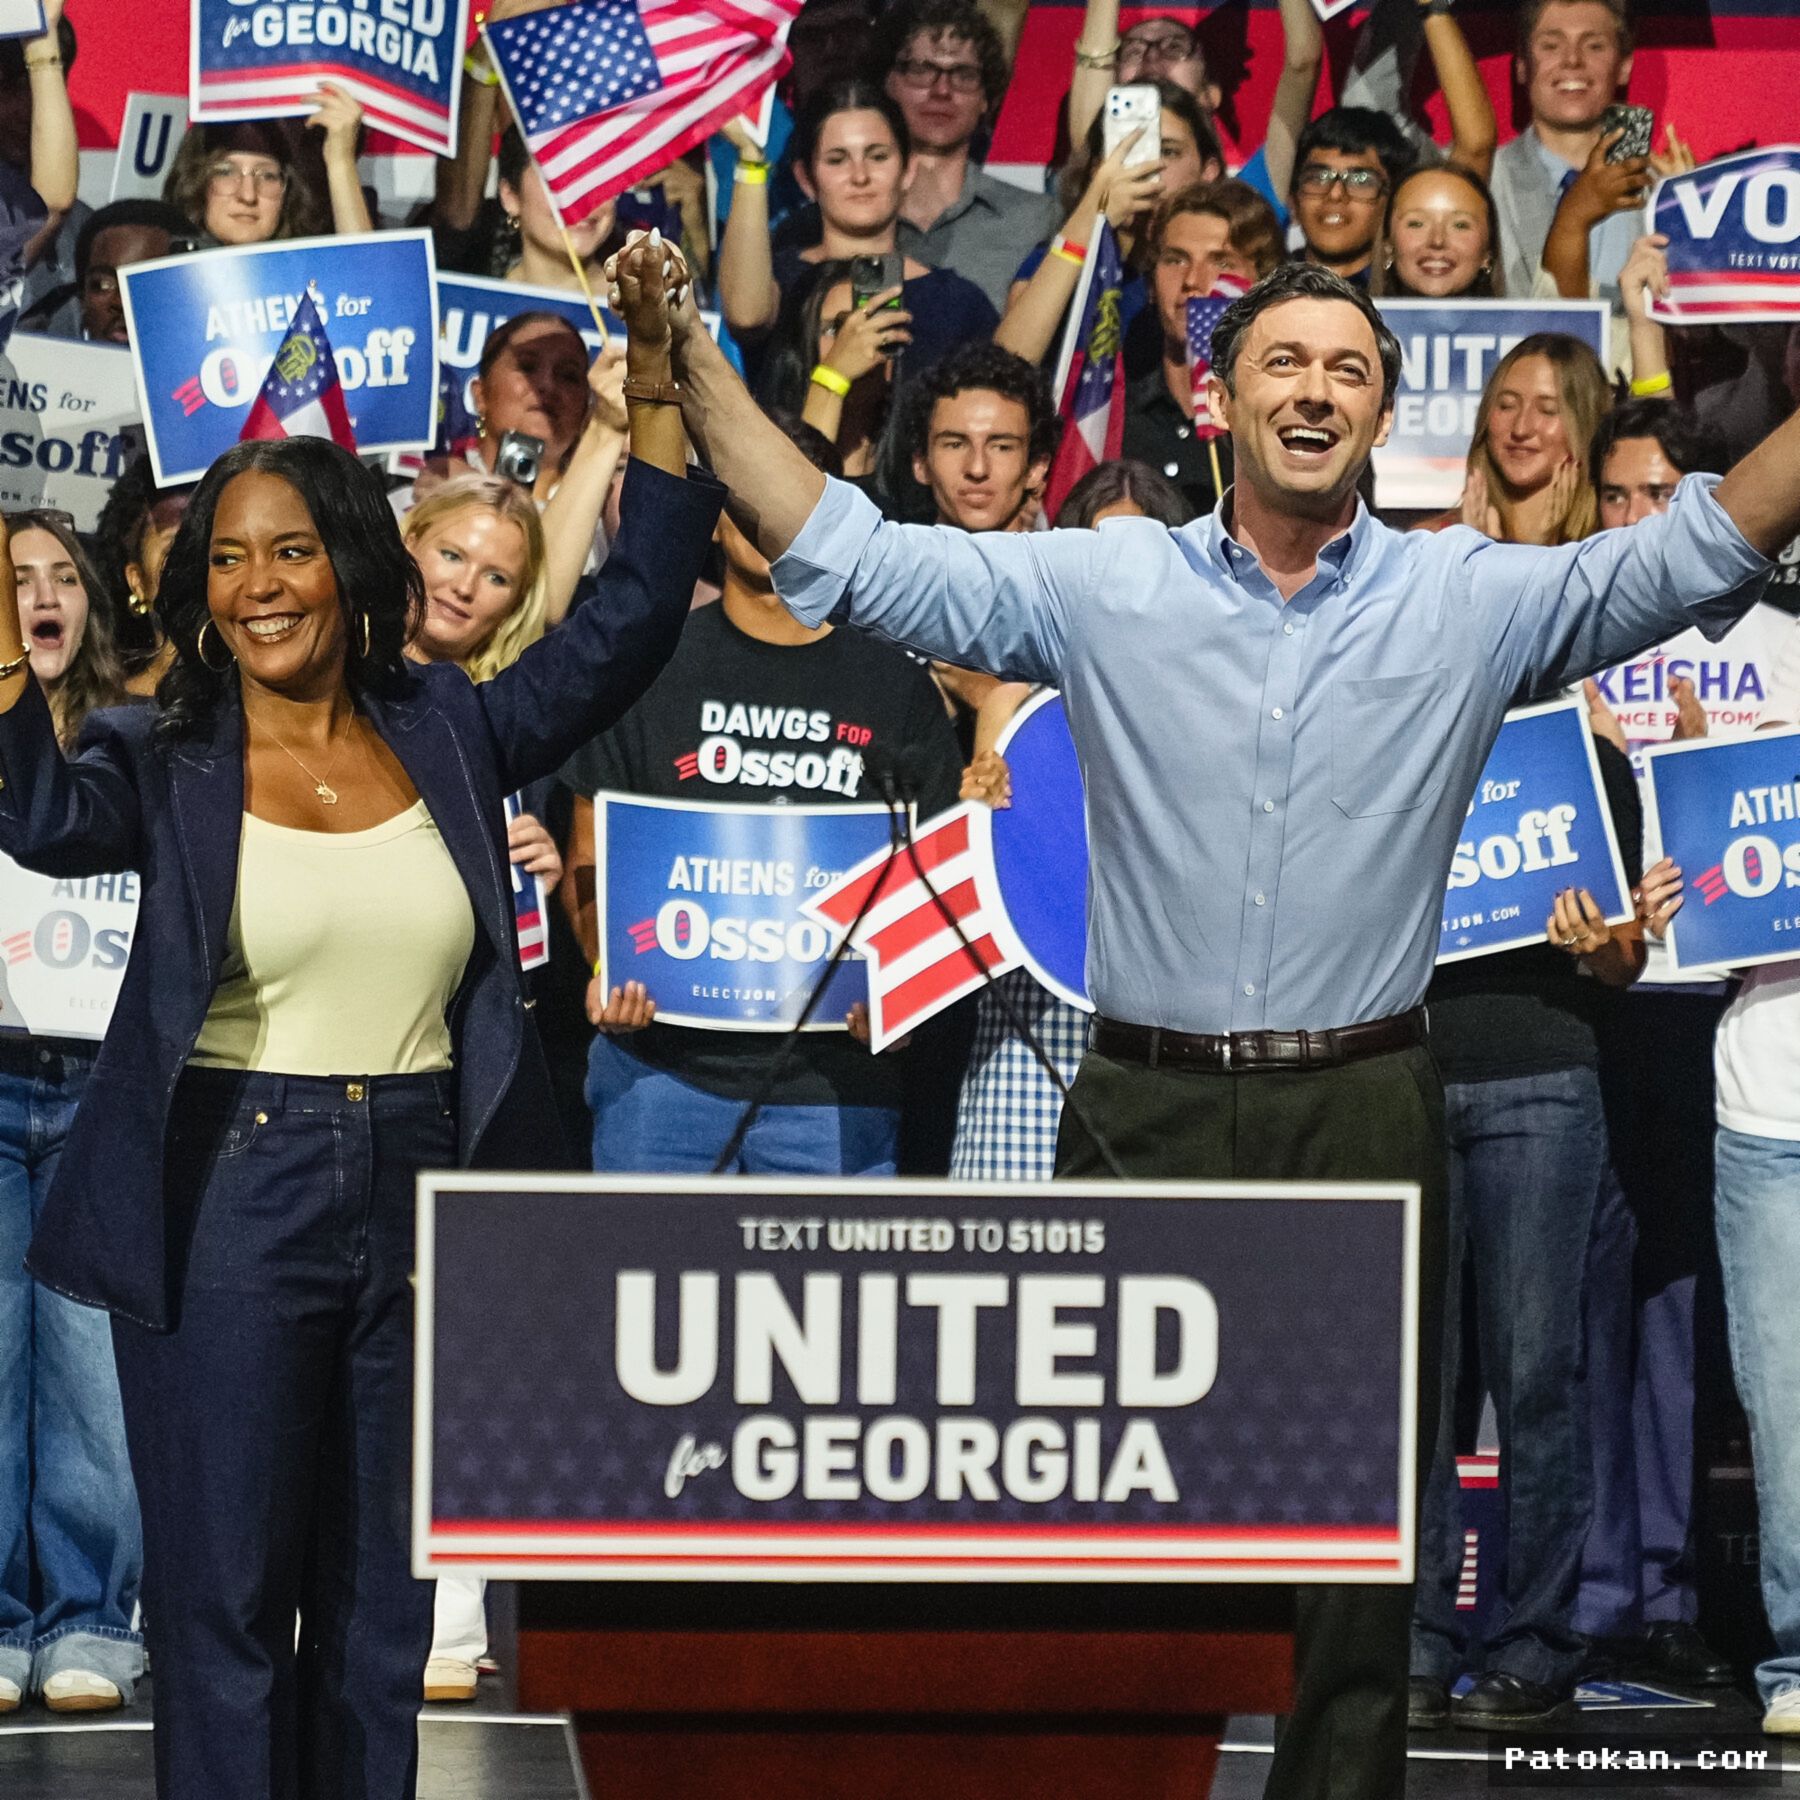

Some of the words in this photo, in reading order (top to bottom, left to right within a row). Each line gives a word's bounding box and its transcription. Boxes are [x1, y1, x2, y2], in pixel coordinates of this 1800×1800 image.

[222, 16, 251, 48] for
[251, 4, 440, 84] GEORGIA
[1730, 253, 1763, 267] TEXT
[1768, 256, 1800, 270] VOT
[336, 292, 372, 317] for
[58, 391, 96, 413] for
[701, 700, 832, 743] DAWGS
[836, 722, 873, 747] FOR
[697, 735, 866, 798] Ossoff
[1481, 779, 1521, 804] for
[668, 855, 795, 898] ATHENS
[655, 900, 868, 963] Osso
[738, 1217, 825, 1251] TEXT
[827, 1218, 954, 1252] UNITED
[958, 1220, 1003, 1252] TO
[1006, 1220, 1105, 1253] 51015
[615, 1269, 1219, 1407] UNITED
[664, 1432, 728, 1499] for
[731, 1413, 1180, 1503] GEORGIA
